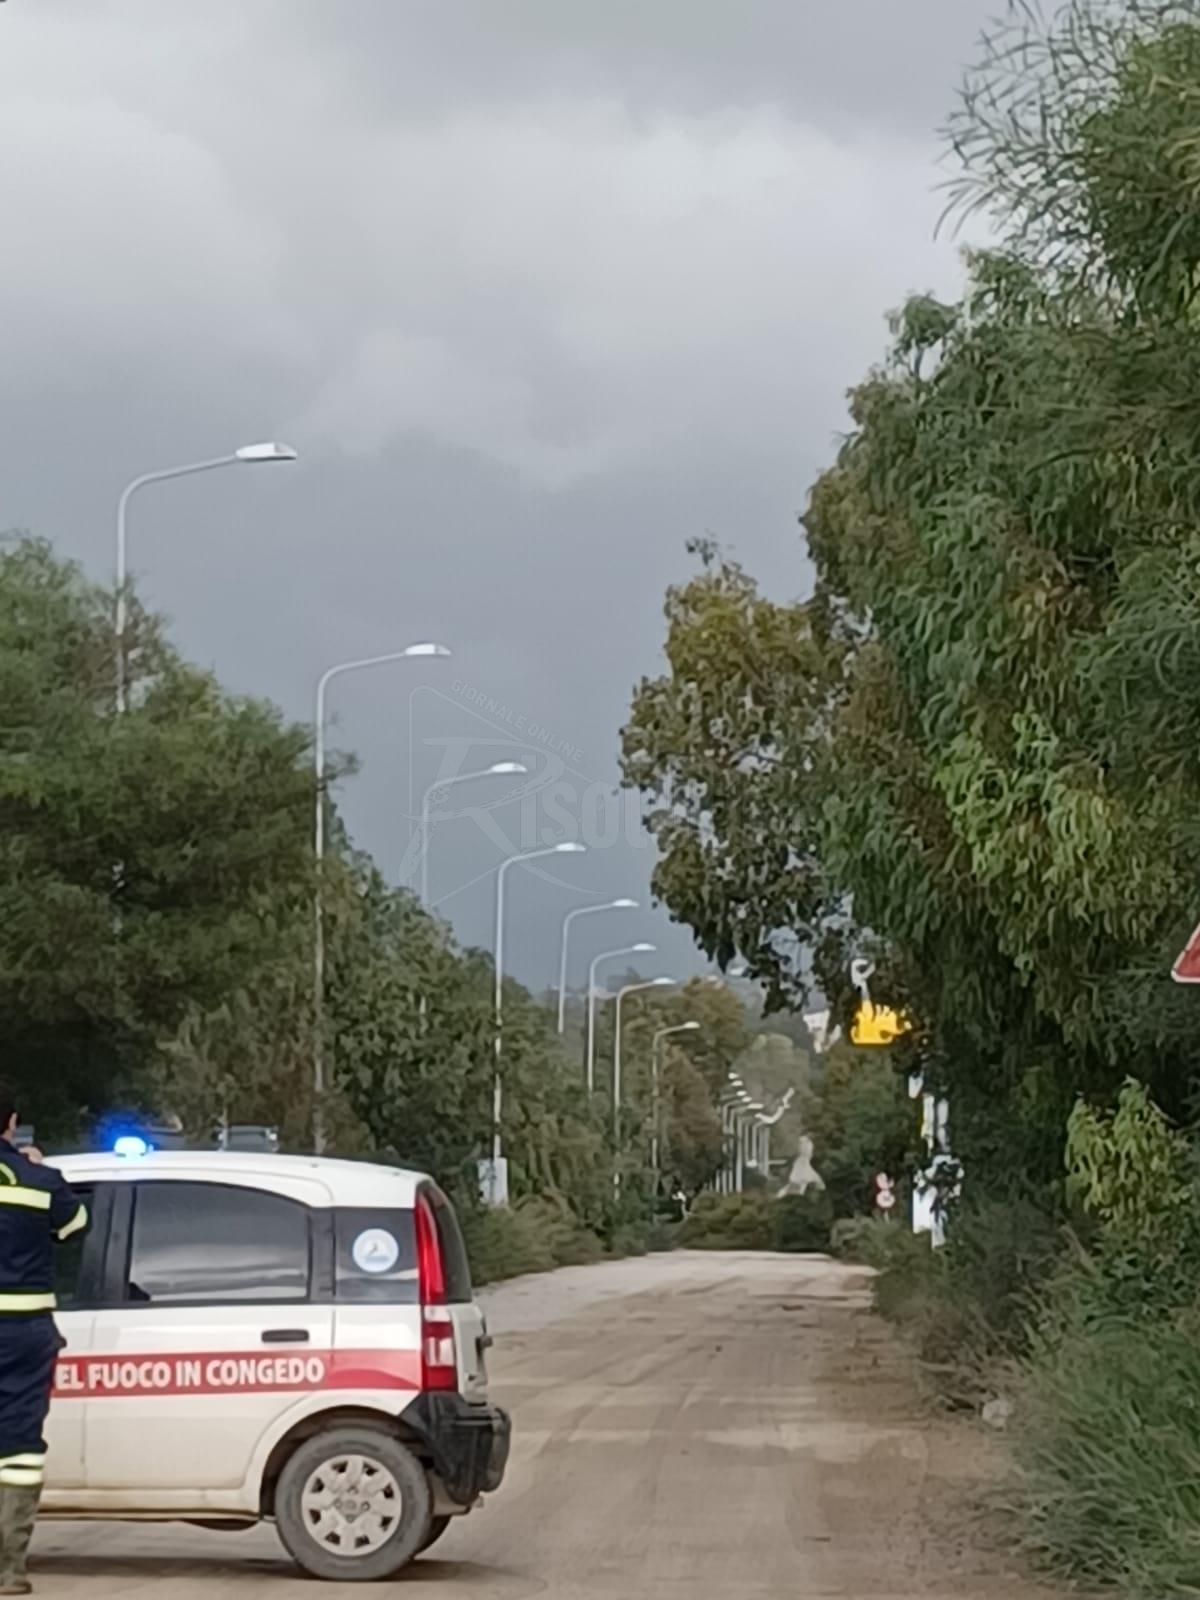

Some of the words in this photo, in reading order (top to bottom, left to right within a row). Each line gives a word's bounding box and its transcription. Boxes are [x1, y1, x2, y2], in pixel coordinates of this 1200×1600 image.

[54, 1363, 85, 1390] EL
[88, 1360, 171, 1389] FUOCO
[175, 1360, 202, 1387] IN
[205, 1357, 325, 1387] CONGEDO
